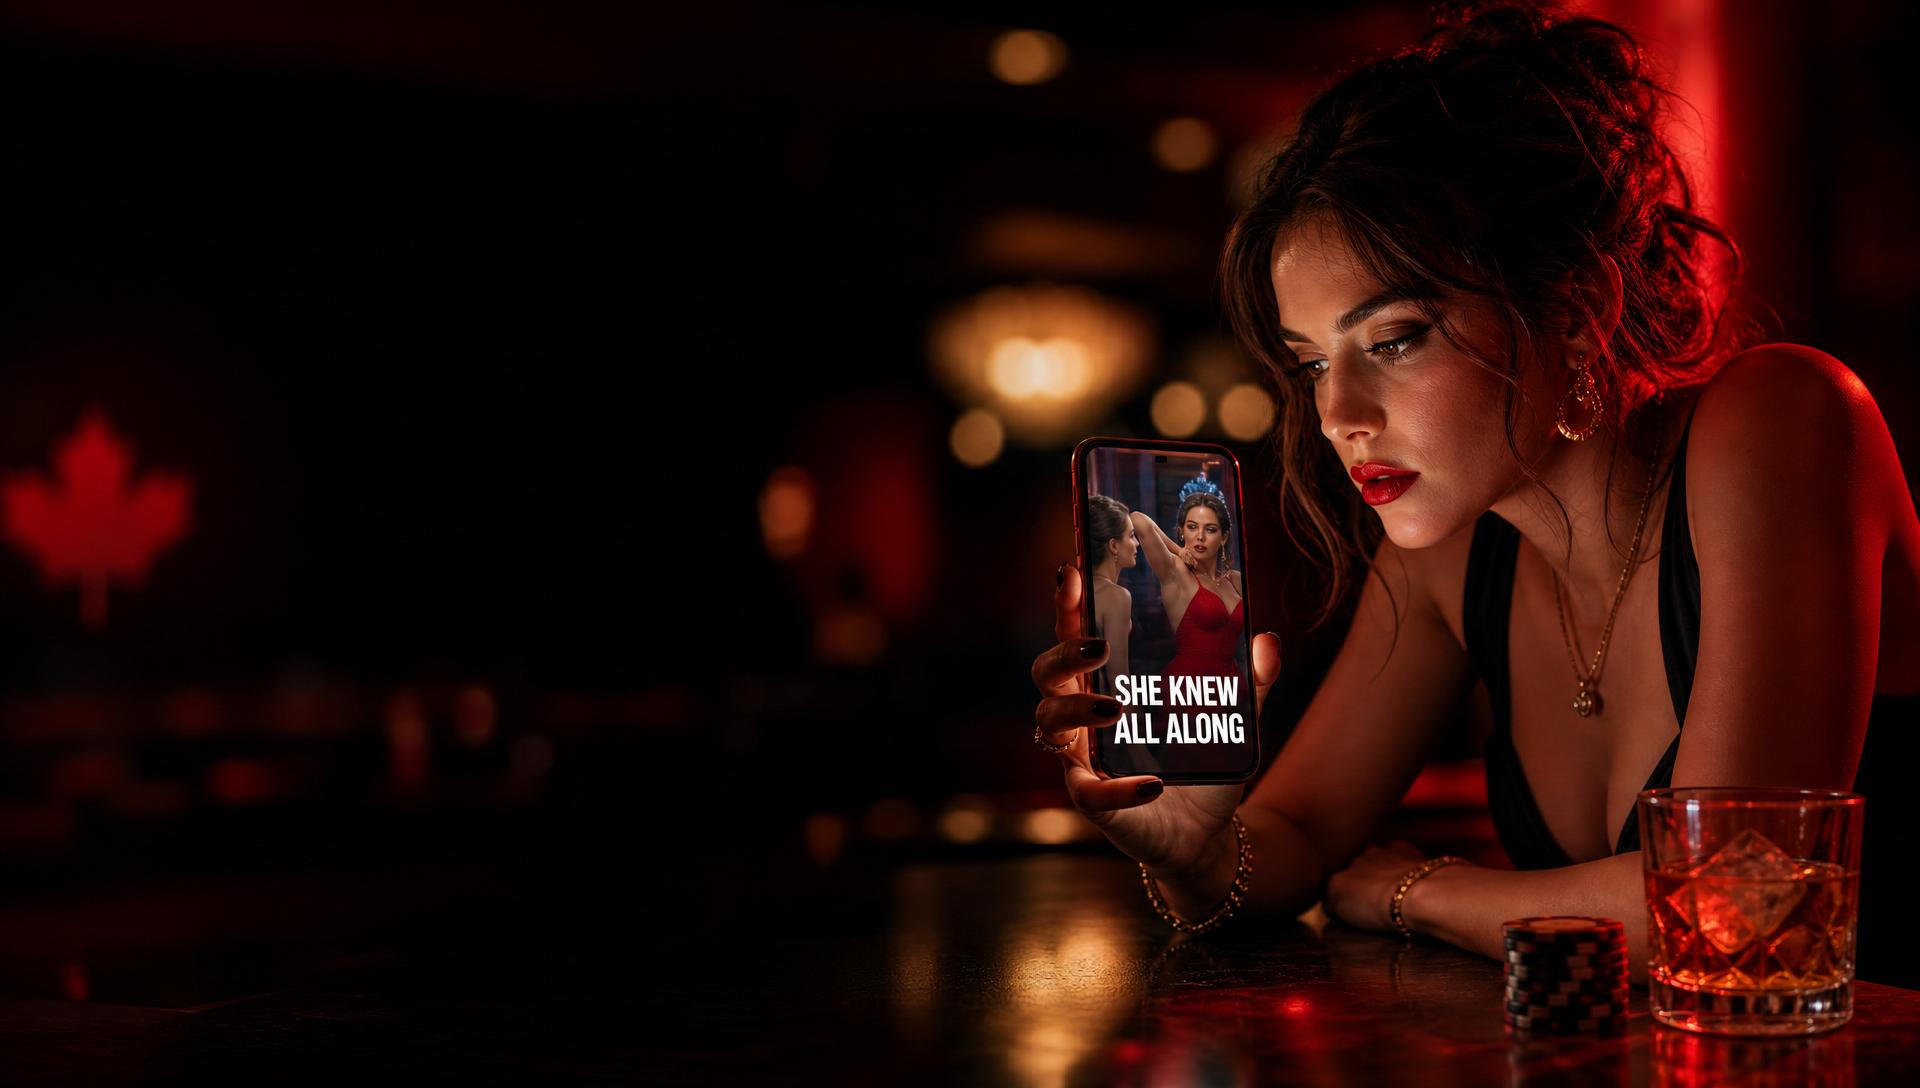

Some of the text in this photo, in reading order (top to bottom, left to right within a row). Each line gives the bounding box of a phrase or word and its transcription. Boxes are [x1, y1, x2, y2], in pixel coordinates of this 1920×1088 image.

[1115, 674, 1239, 706] SHE KNEW
[1114, 712, 1245, 744] ALL ALONG
